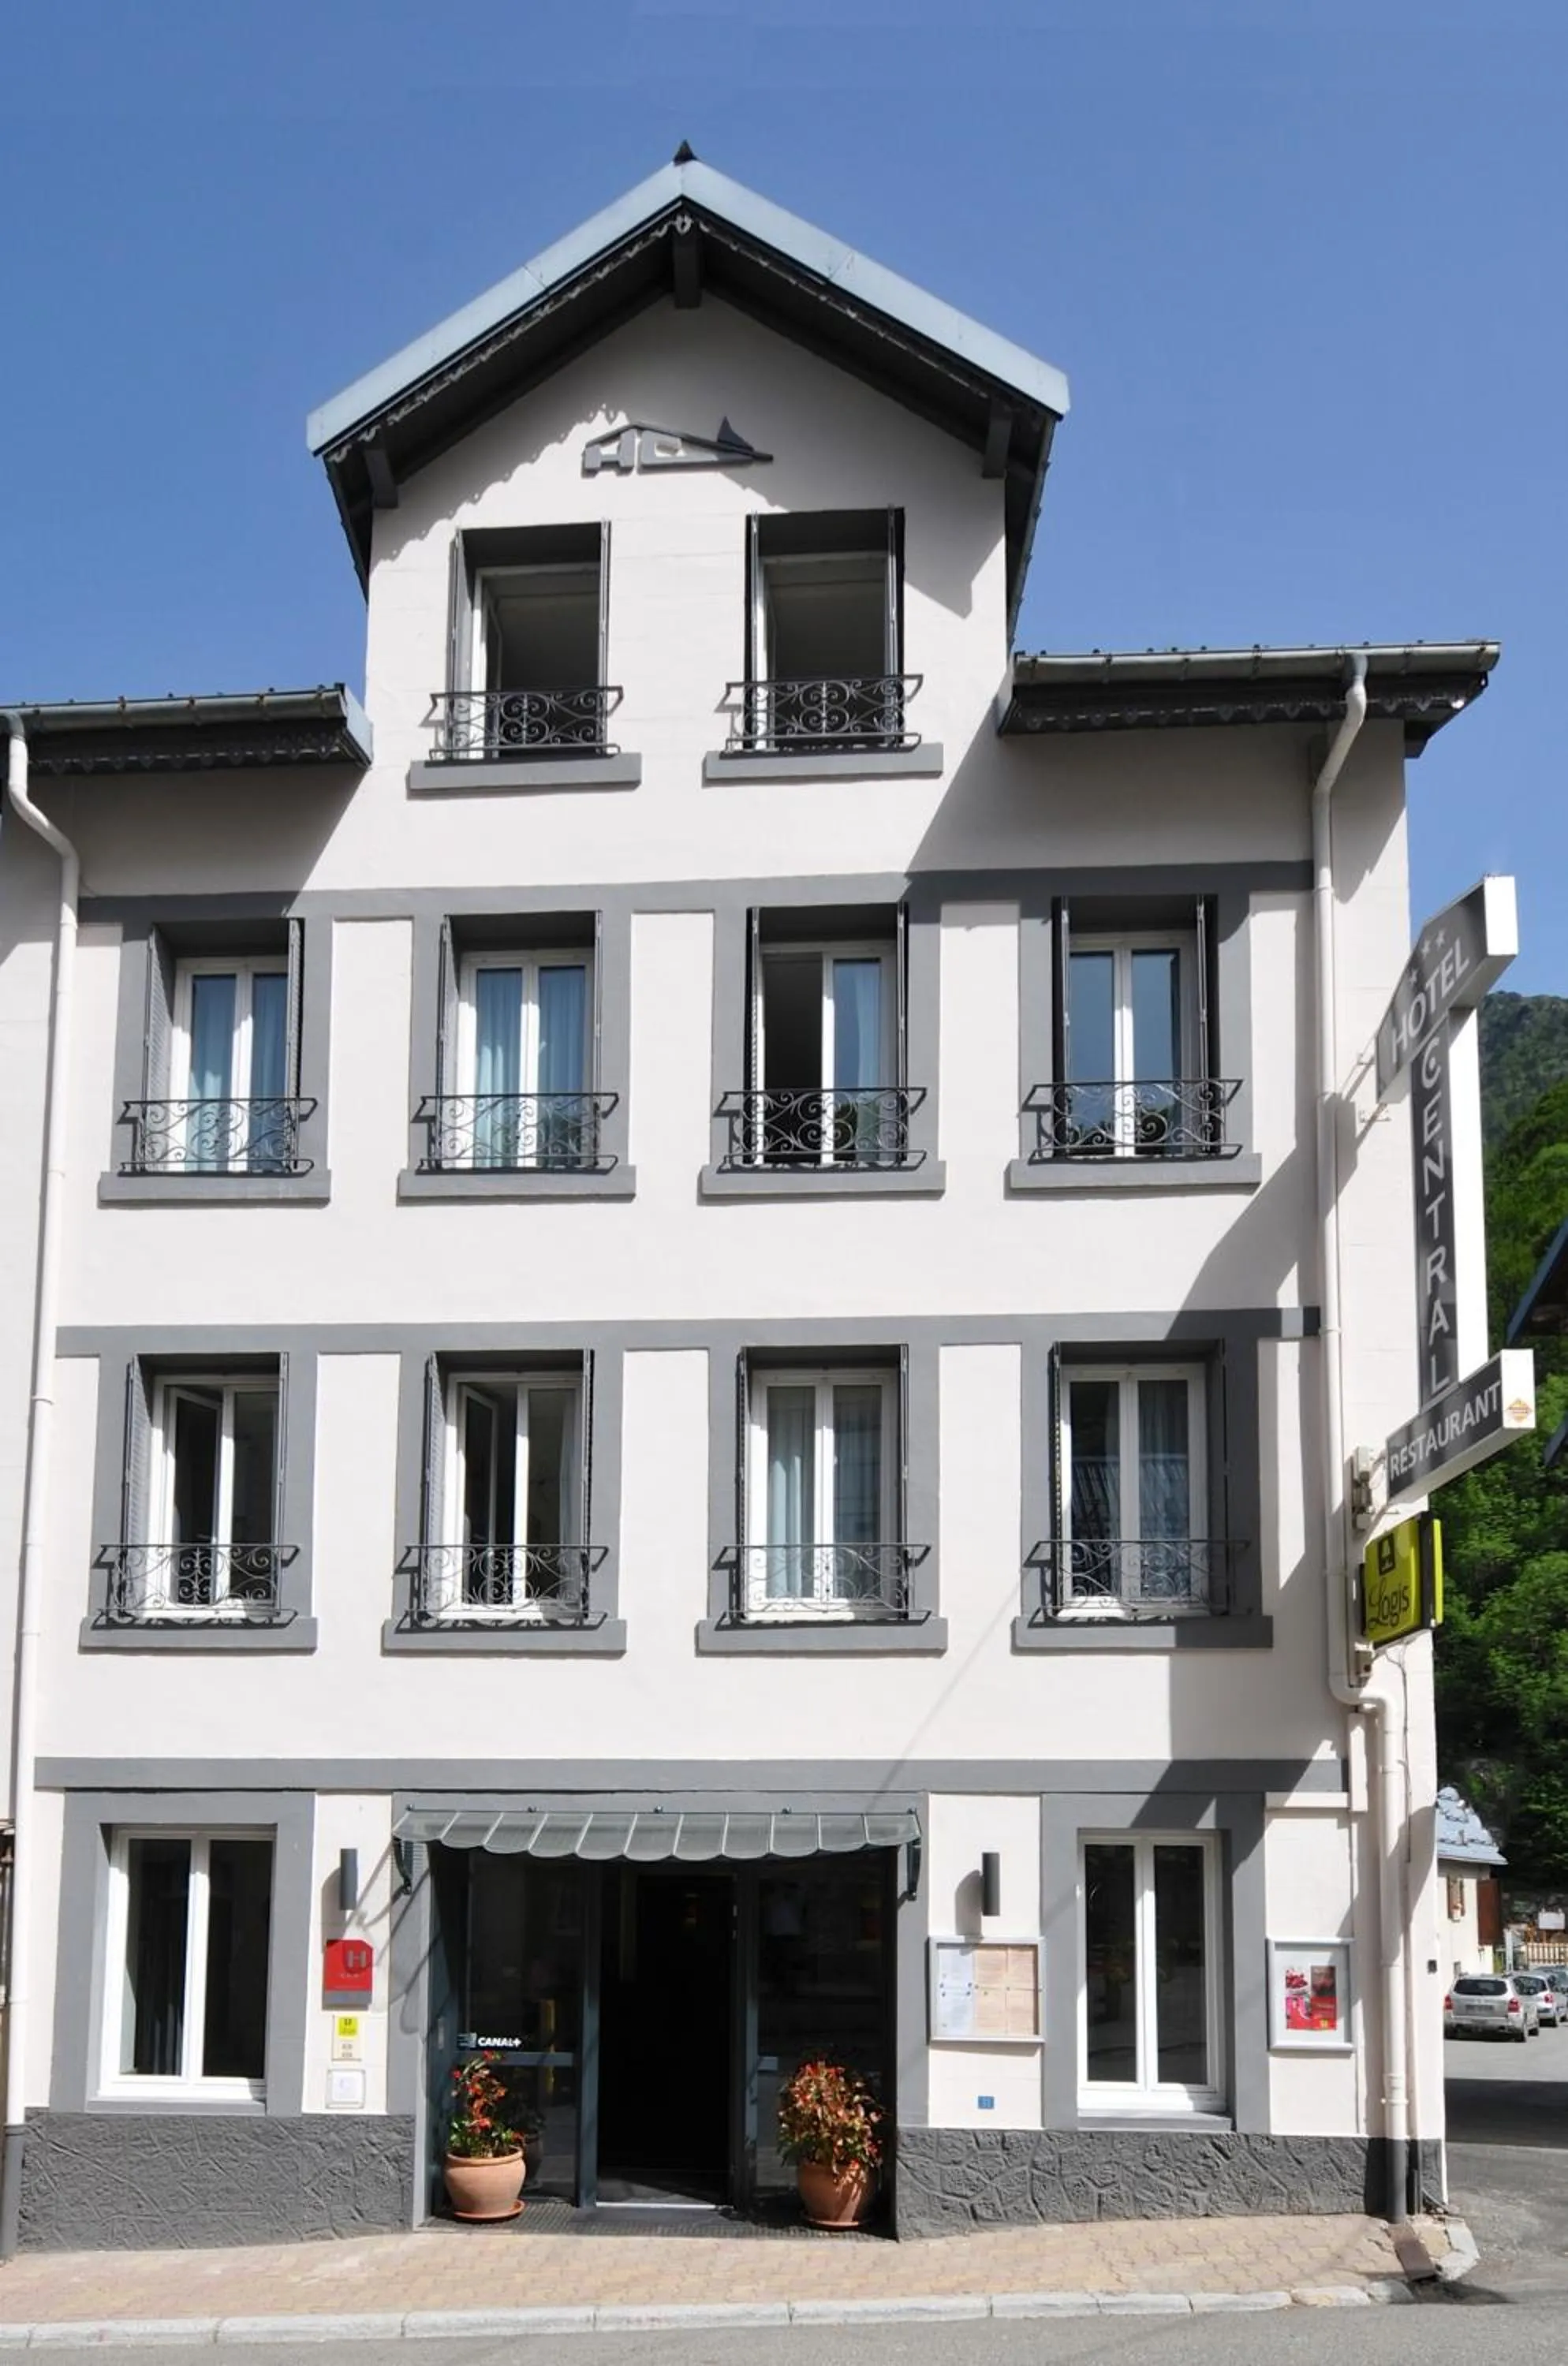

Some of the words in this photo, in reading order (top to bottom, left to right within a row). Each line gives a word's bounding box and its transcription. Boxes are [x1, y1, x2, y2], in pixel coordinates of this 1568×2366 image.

[1391, 938, 1469, 1062] HOTEL
[1421, 1037, 1450, 1395] CENTRAL
[1390, 1381, 1501, 1480] RESTAURANT
[1368, 1579, 1409, 1629] Logis
[346, 1950, 367, 1969] H
